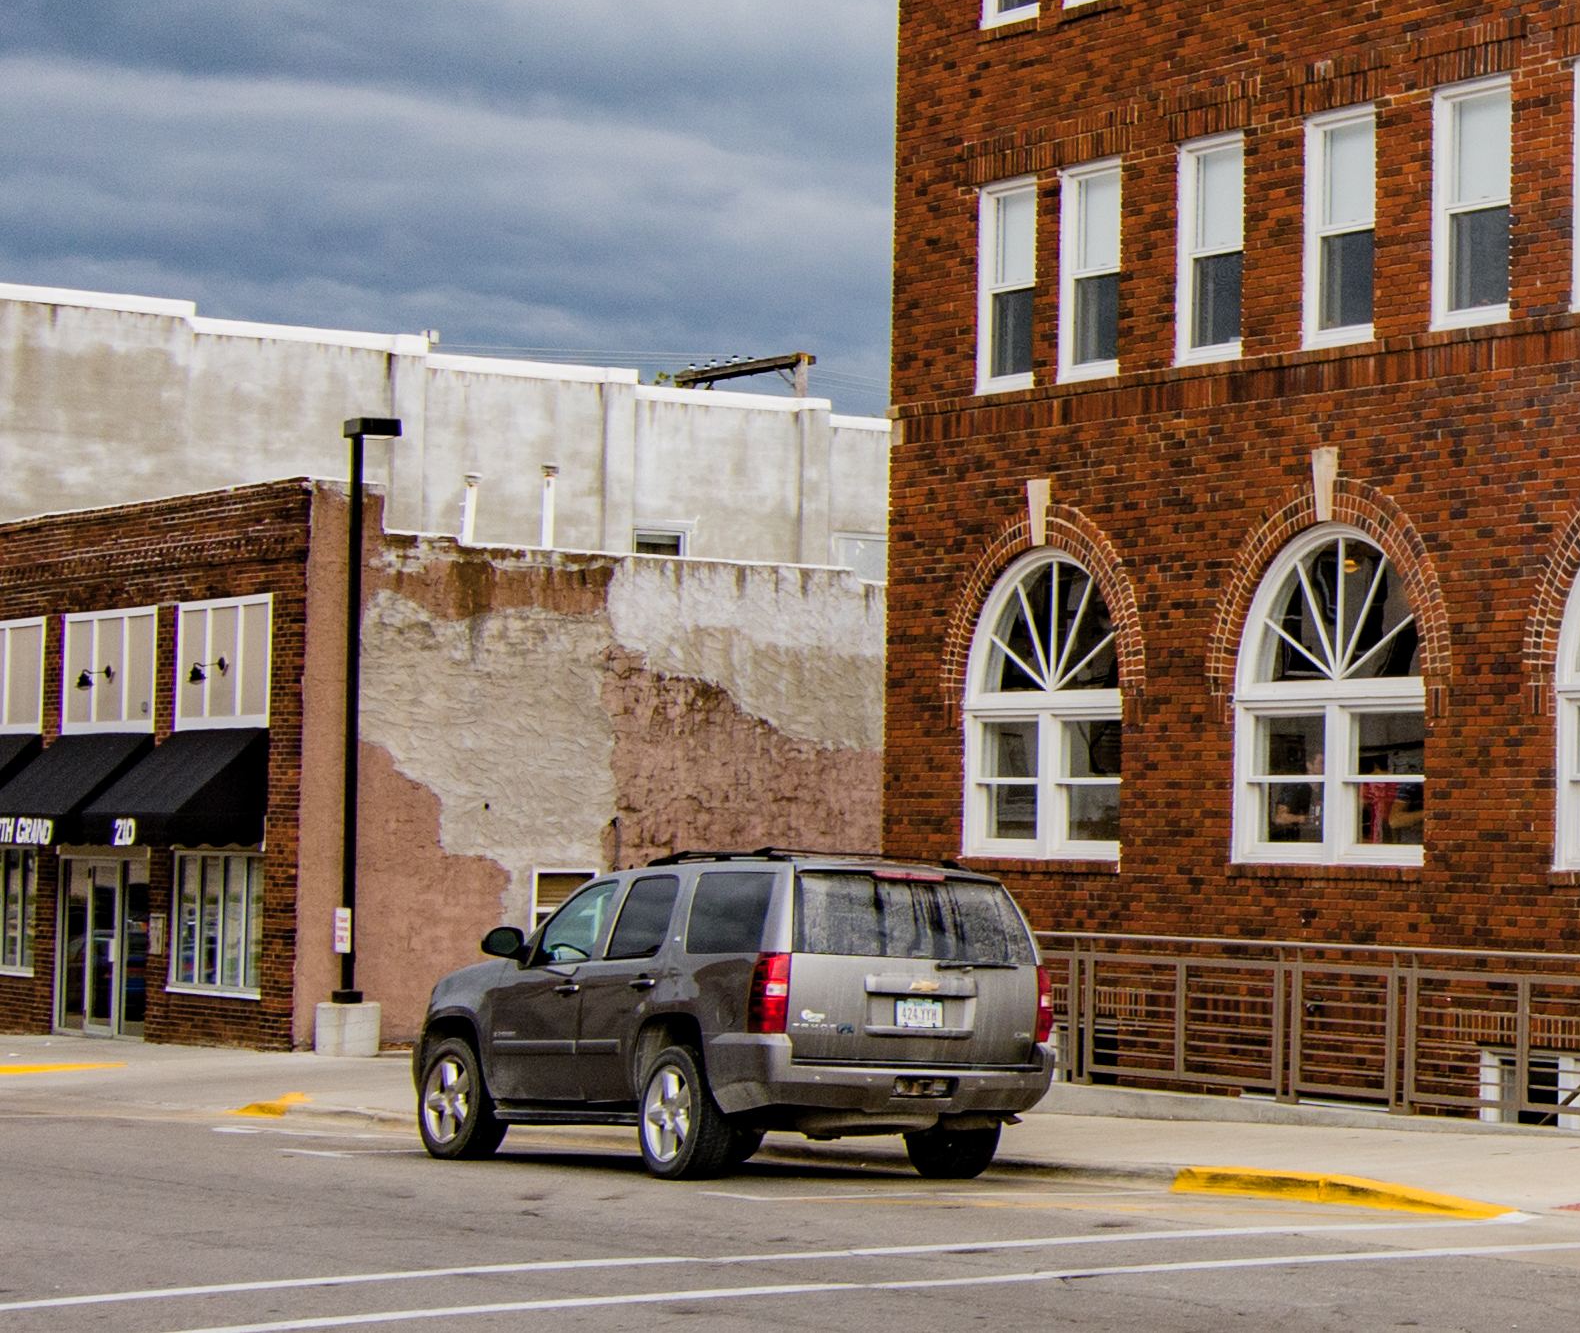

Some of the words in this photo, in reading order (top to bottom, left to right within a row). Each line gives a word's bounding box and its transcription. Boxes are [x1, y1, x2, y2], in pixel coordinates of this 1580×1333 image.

[0, 817, 15, 843] TH
[16, 817, 53, 845] GRAND
[113, 818, 136, 846] 210
[902, 1007, 918, 1020] 424
[921, 1008, 937, 1021] YYH
